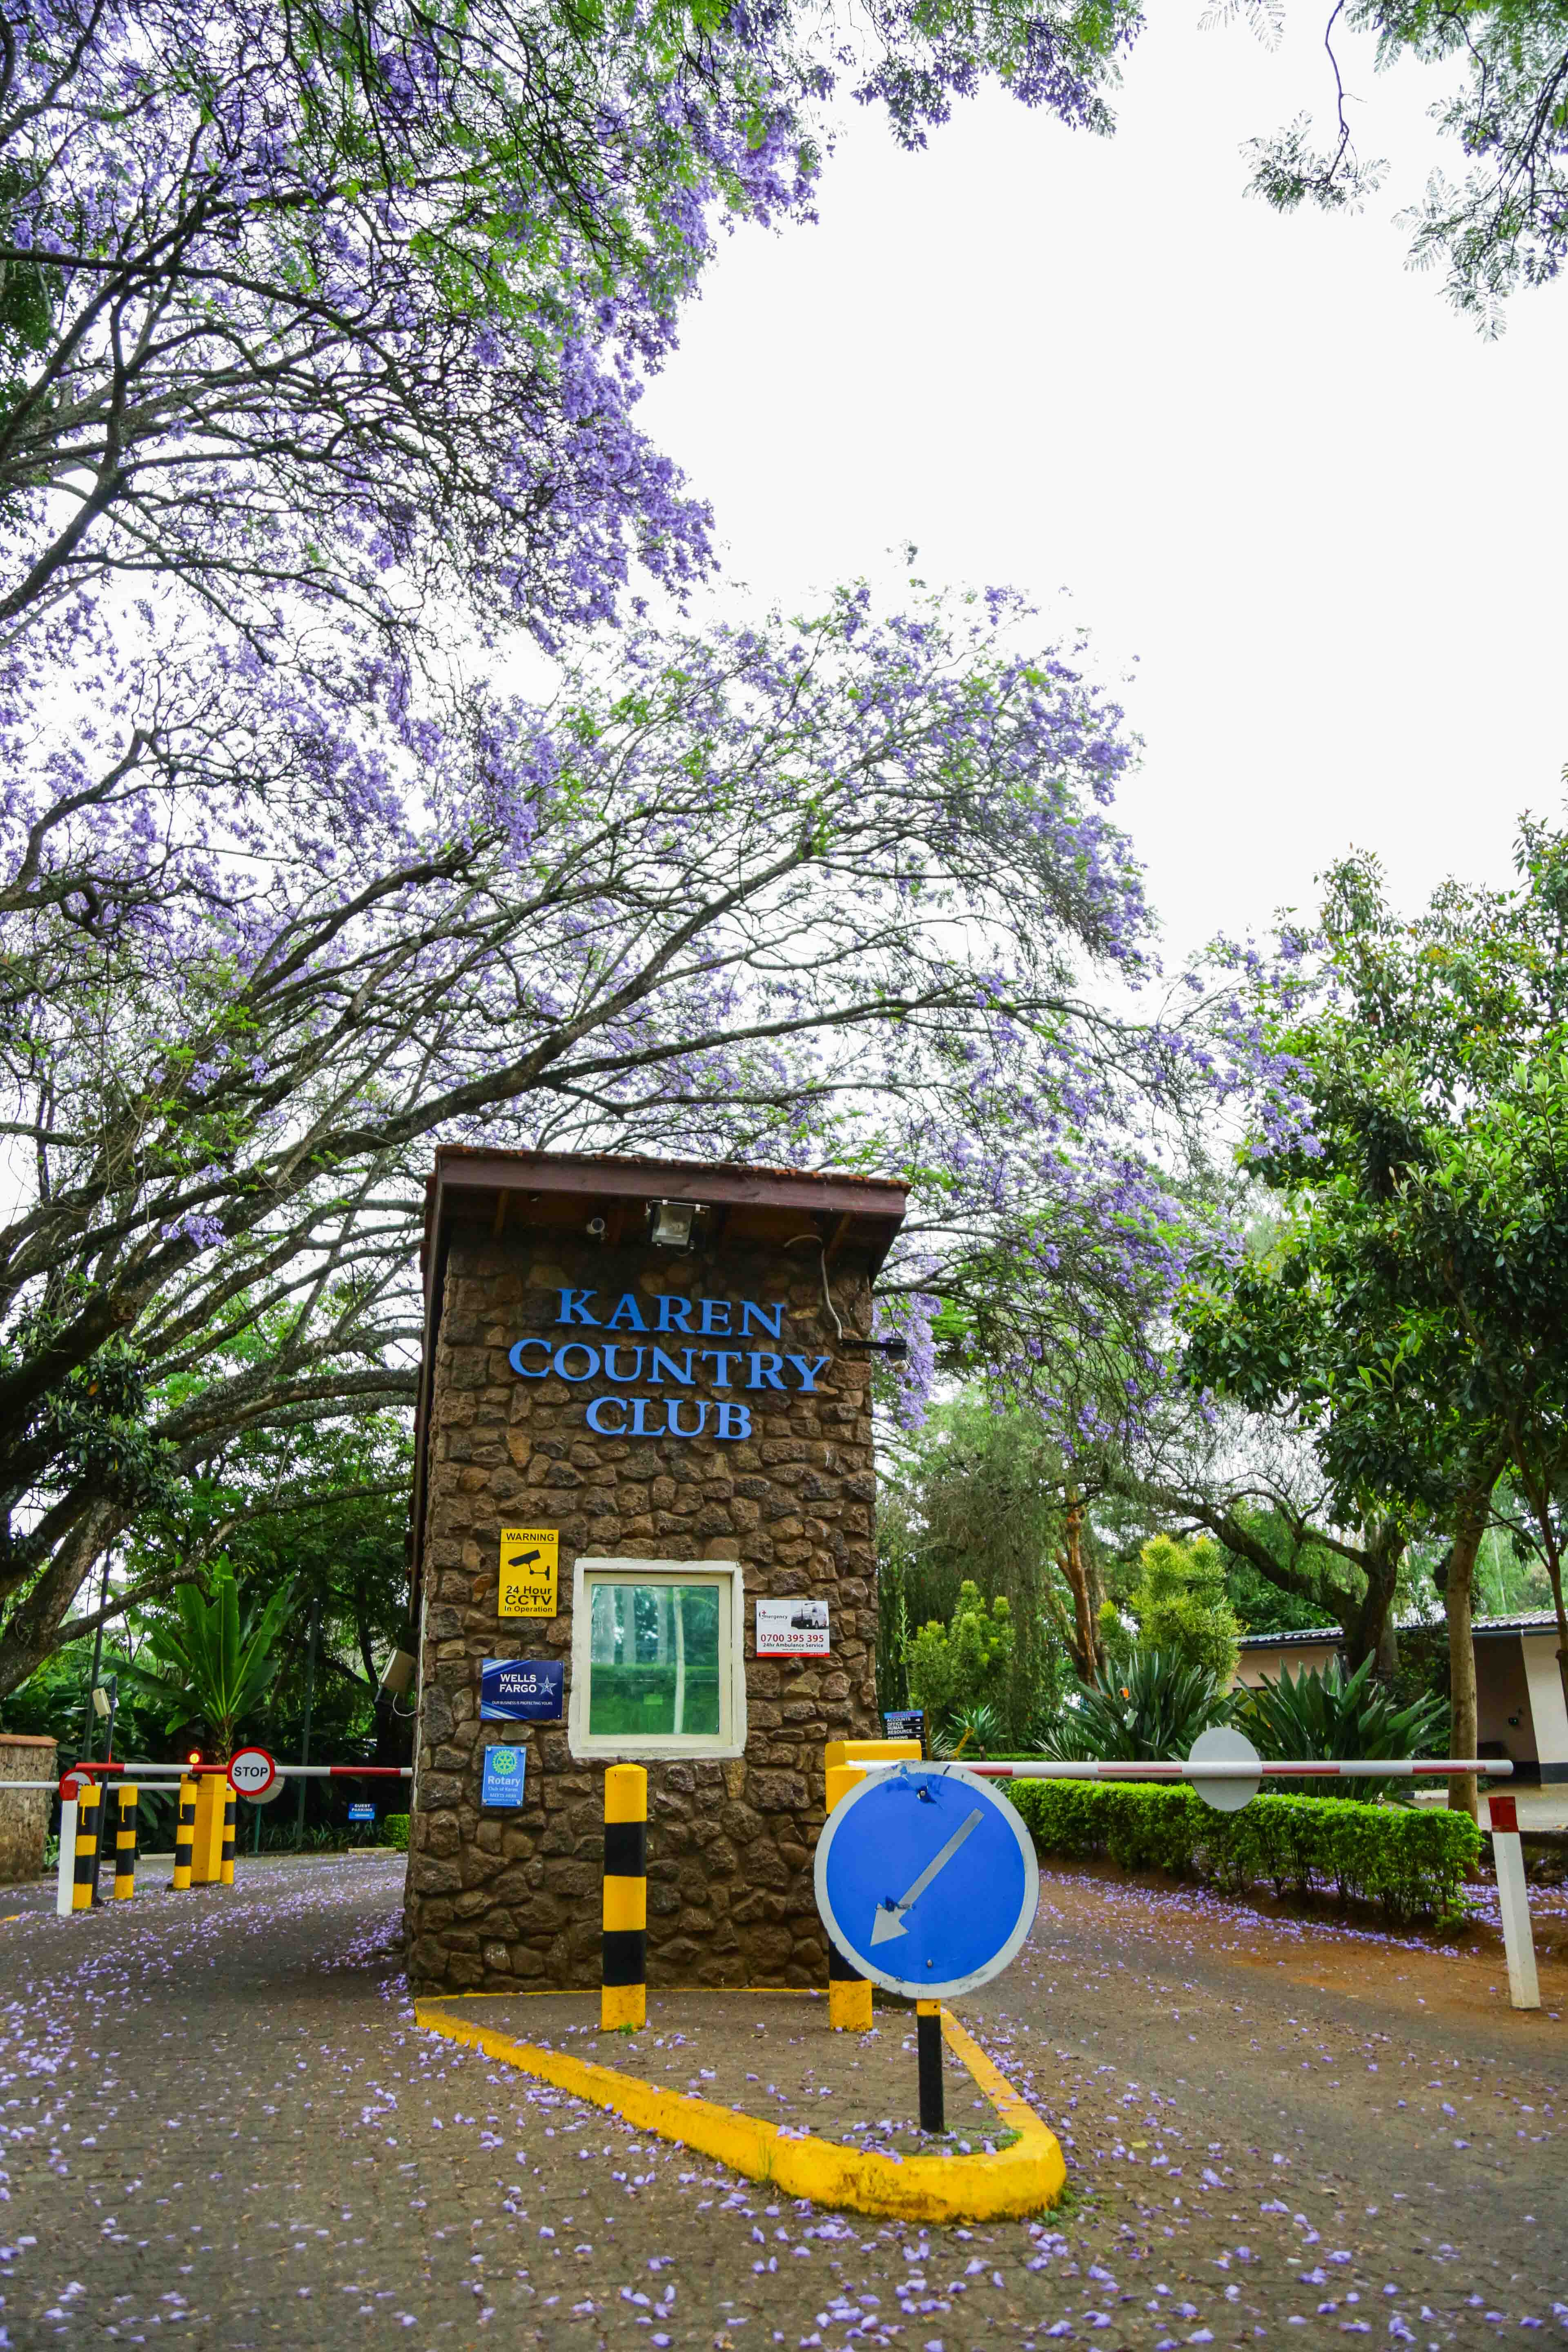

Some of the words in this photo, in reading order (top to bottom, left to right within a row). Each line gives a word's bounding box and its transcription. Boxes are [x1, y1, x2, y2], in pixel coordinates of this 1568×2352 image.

[555, 1287, 786, 1339] KAREN
[509, 1338, 830, 1392] COUNTRY
[586, 1396, 752, 1440] CLUB
[506, 1533, 555, 1541] WARNING
[506, 1586, 519, 1594] 24
[524, 1586, 552, 1595] Hour
[505, 1595, 552, 1605] CCTV
[500, 1674, 536, 1682] WELLS
[499, 1684, 537, 1693] FARGO
[234, 1766, 268, 1777] STOP
[488, 1776, 521, 1787] Rotary
